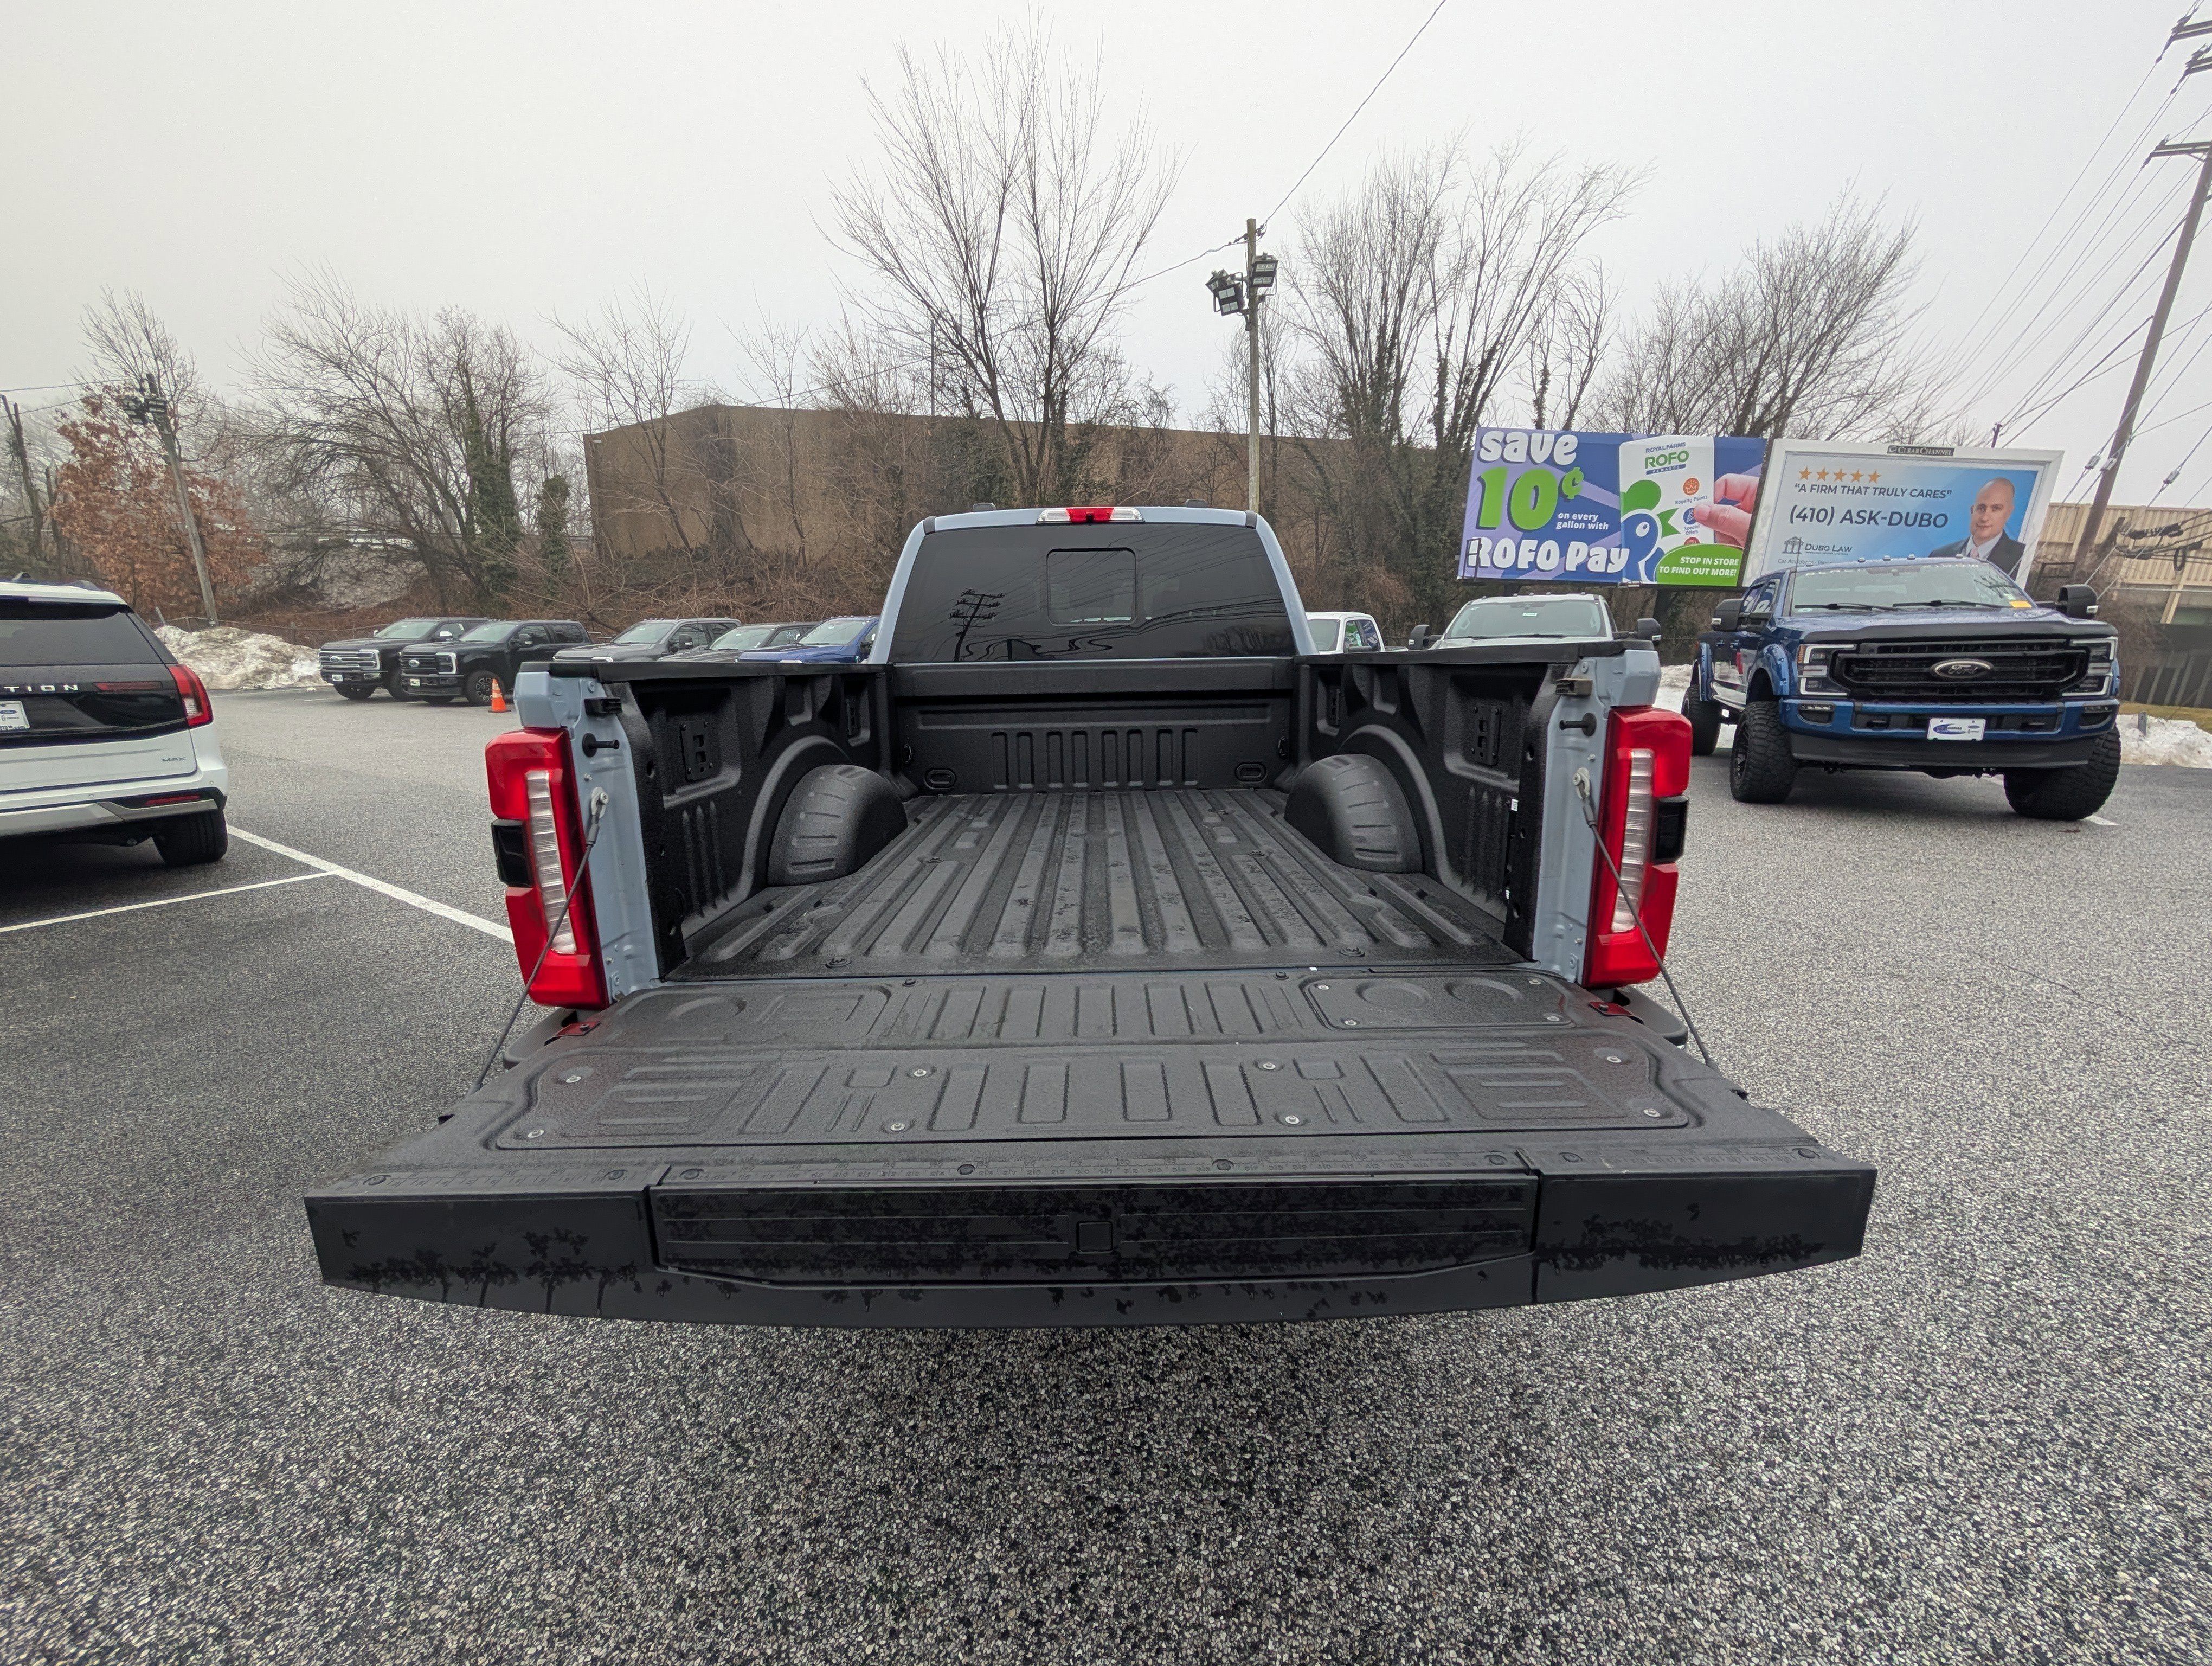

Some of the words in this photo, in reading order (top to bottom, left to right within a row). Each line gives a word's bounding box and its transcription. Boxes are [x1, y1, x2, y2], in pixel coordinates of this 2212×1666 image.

[1478, 431, 1578, 465] save
[1645, 450, 1689, 469] ROFO
[1810, 484, 1838, 494] FIRM
[1841, 485, 1870, 495] THAT
[1873, 487, 1908, 497] TRULY
[1572, 514, 1599, 522] every
[1790, 504, 1835, 526] (410)
[1839, 509, 1949, 528] ASK-DUBO
[1556, 521, 1585, 530] gallon
[1804, 543, 1830, 552] DUBO
[1468, 536, 1560, 571] ROFO
[1566, 541, 1630, 574] Pay
[1714, 558, 1739, 566] STORE
[1711, 568, 1737, 576] MORE!
[1947, 664, 1979, 675] Ford
